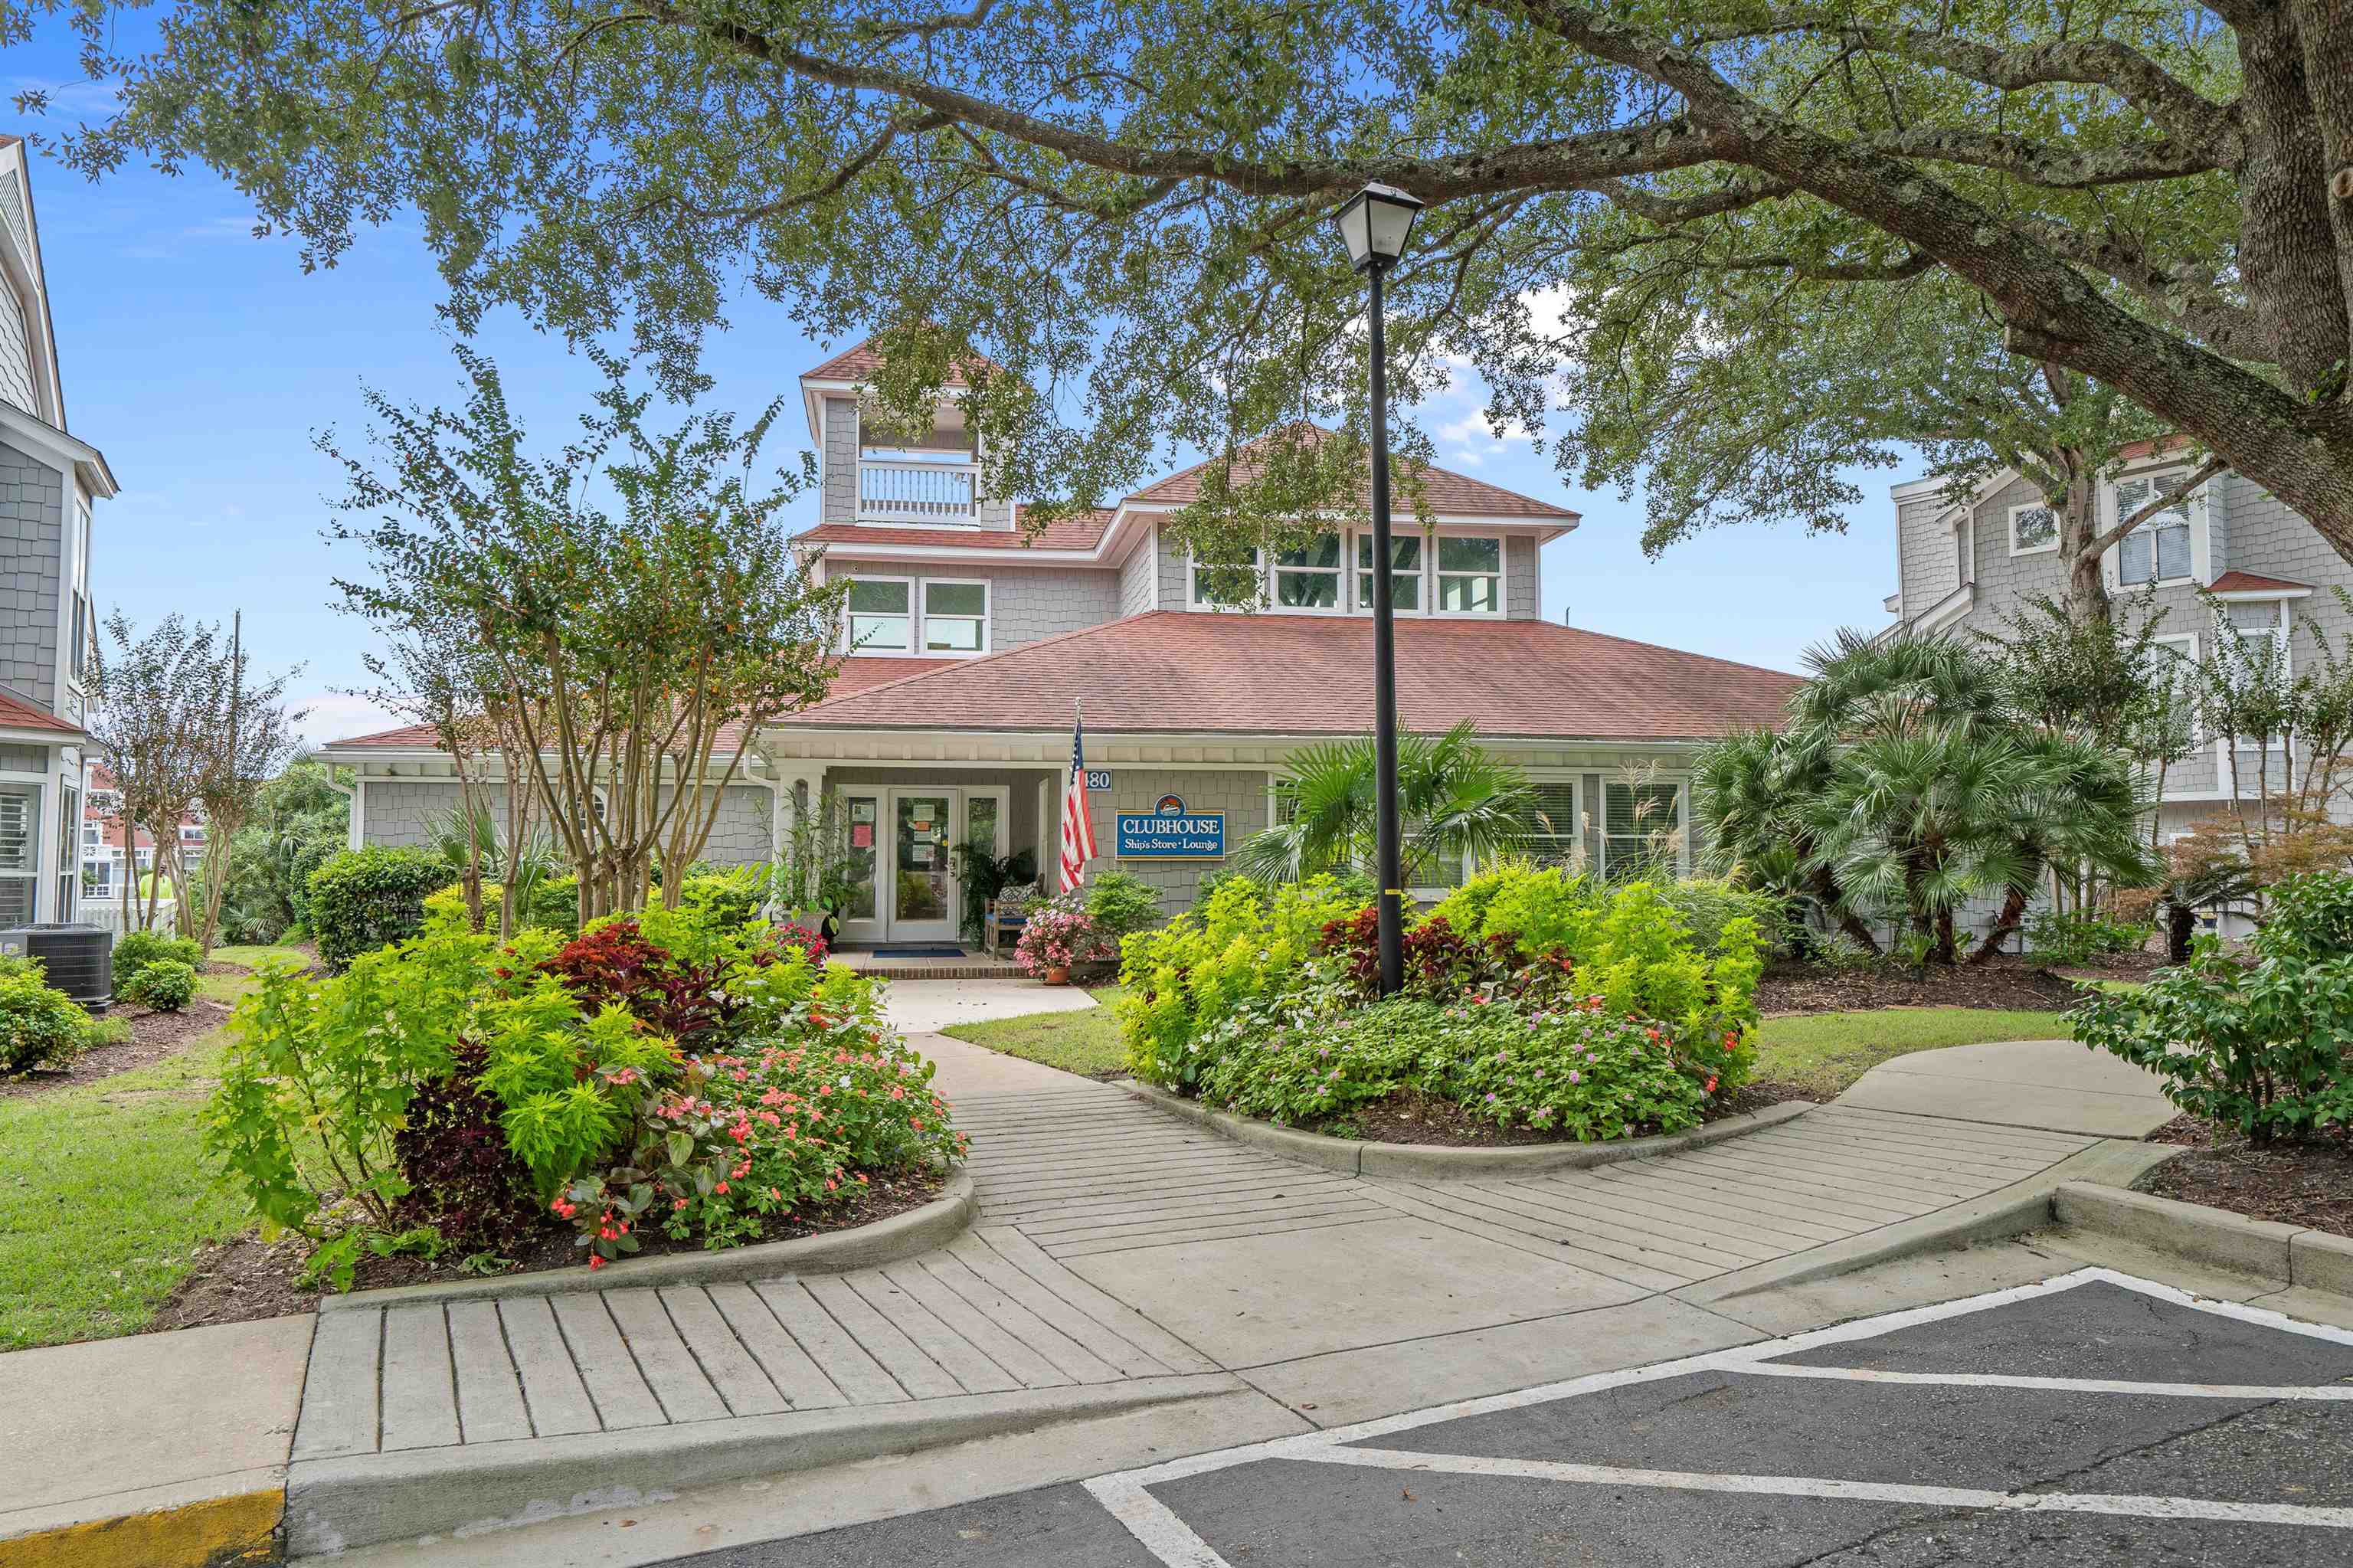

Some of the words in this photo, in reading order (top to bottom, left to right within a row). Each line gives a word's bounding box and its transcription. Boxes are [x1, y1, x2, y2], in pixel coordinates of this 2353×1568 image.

[1123, 819, 1220, 834] CLUBHOUSE
[1124, 838, 1150, 850] Ship's
[1151, 838, 1177, 849] Store
[1183, 838, 1218, 851] Lounge
